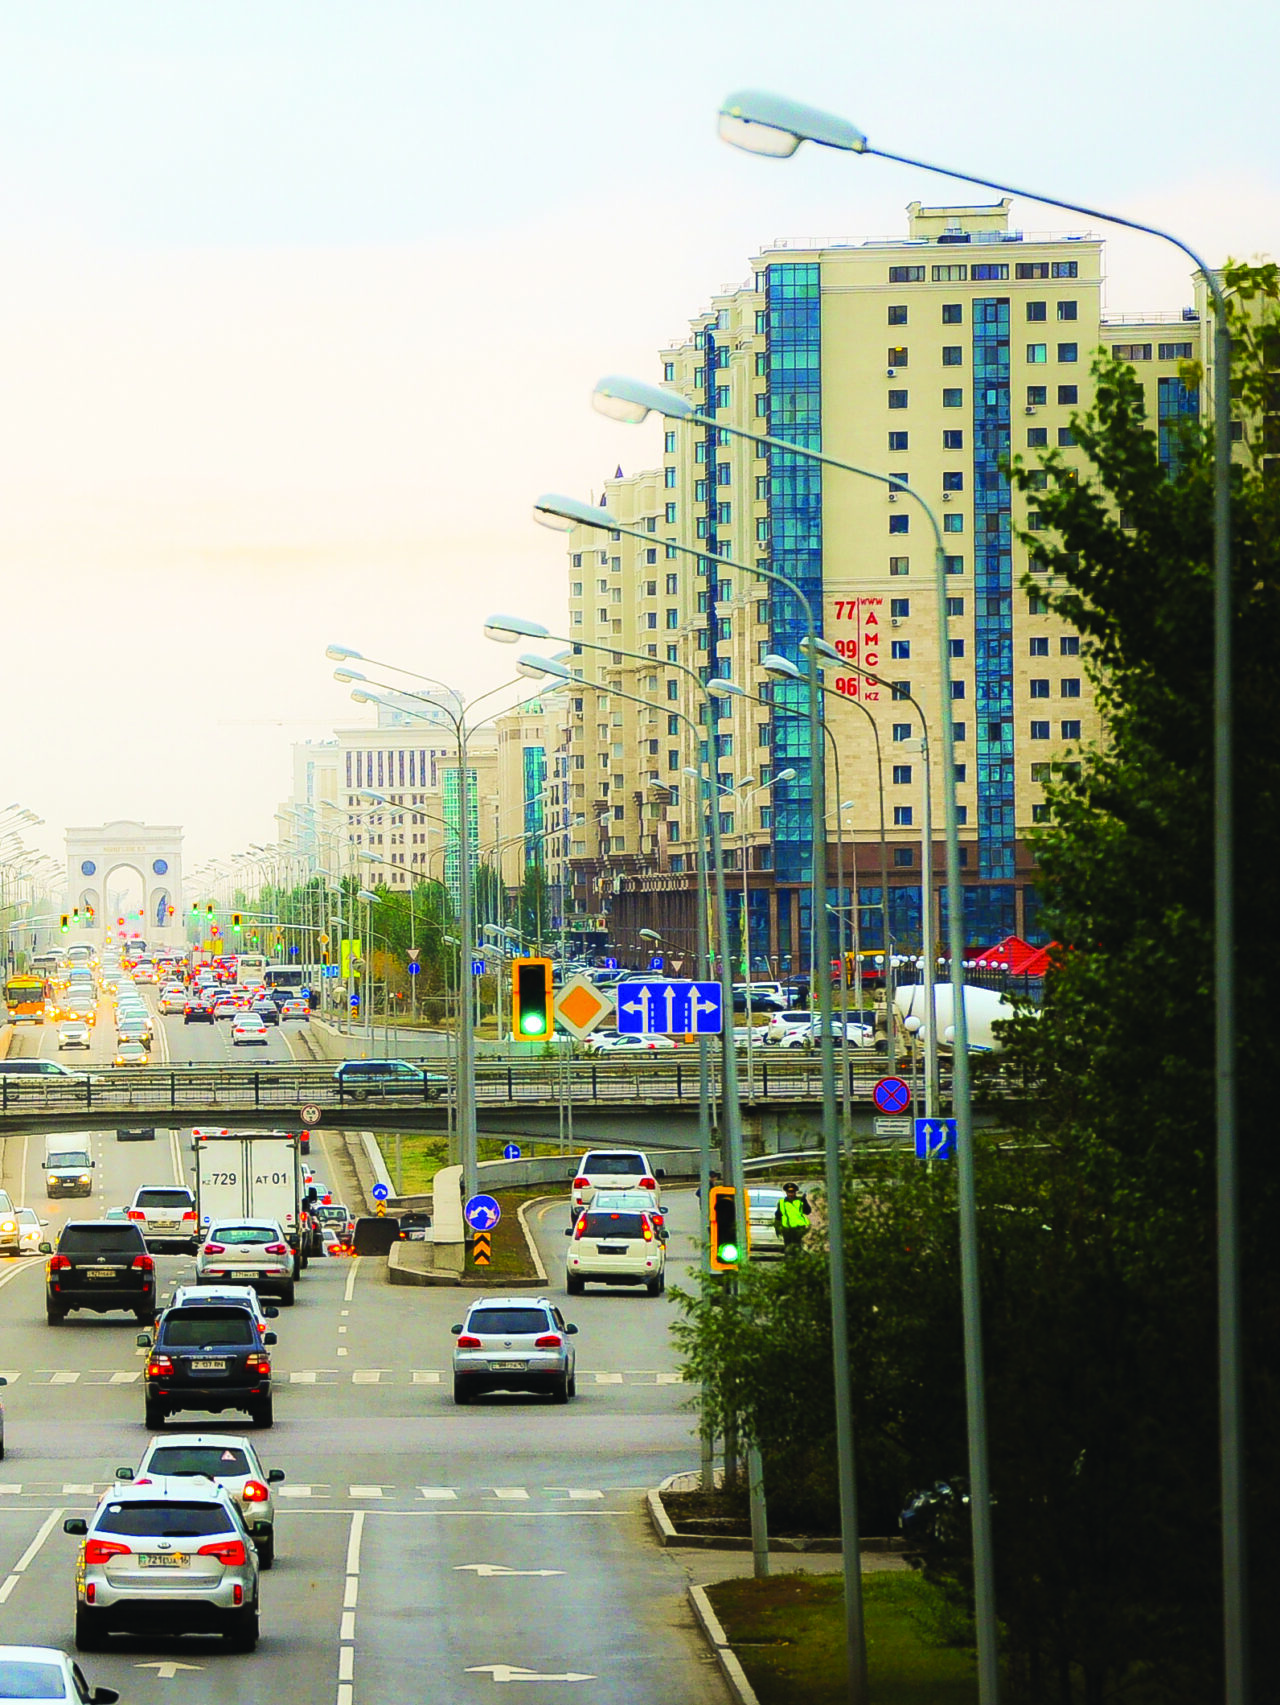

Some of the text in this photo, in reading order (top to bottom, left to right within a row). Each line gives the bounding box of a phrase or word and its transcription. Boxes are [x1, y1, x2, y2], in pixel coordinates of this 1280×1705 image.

[834, 601, 856, 620] 77
[835, 640, 857, 659] 99
[835, 677, 857, 696] 96
[212, 1172, 237, 1185] 729
[255, 1175, 269, 1184] AT
[272, 1172, 287, 1185] 01
